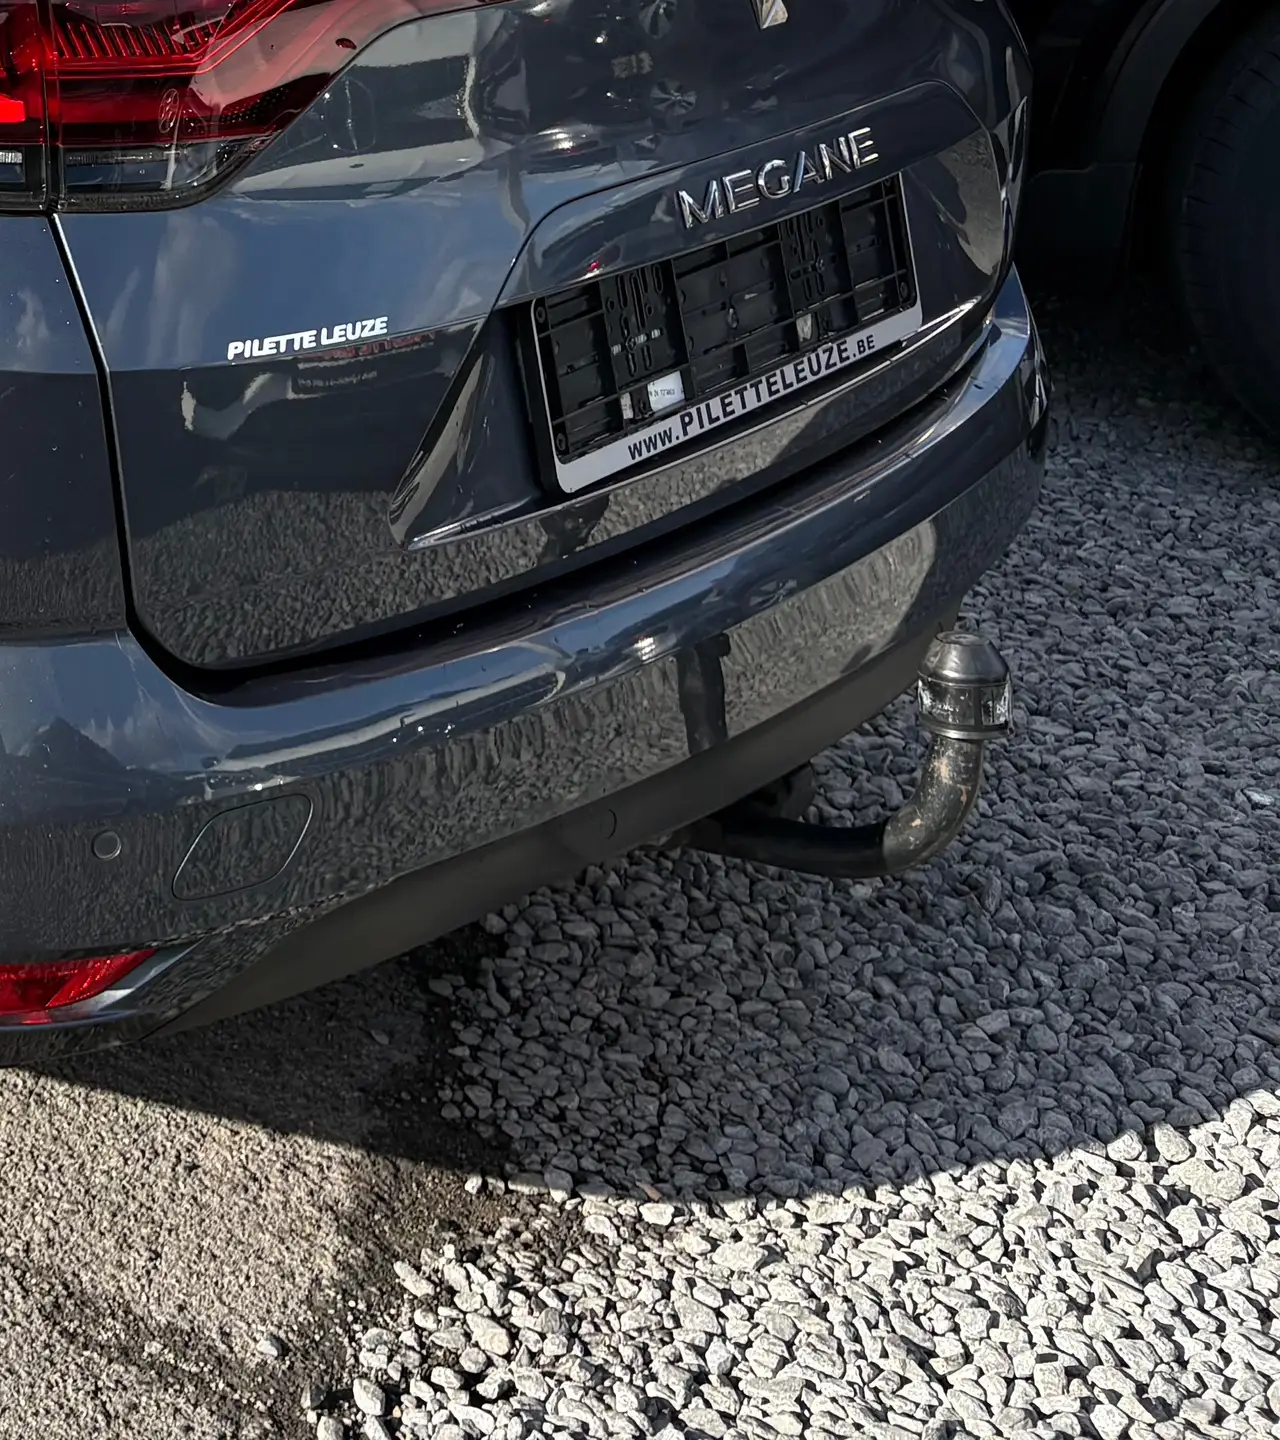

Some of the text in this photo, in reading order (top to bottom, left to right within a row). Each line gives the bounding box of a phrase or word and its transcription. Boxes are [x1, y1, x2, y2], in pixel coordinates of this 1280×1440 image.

[674, 127, 880, 230] MEGANE
[227, 329, 317, 361] PILETTE
[320, 316, 389, 345] LEUZE
